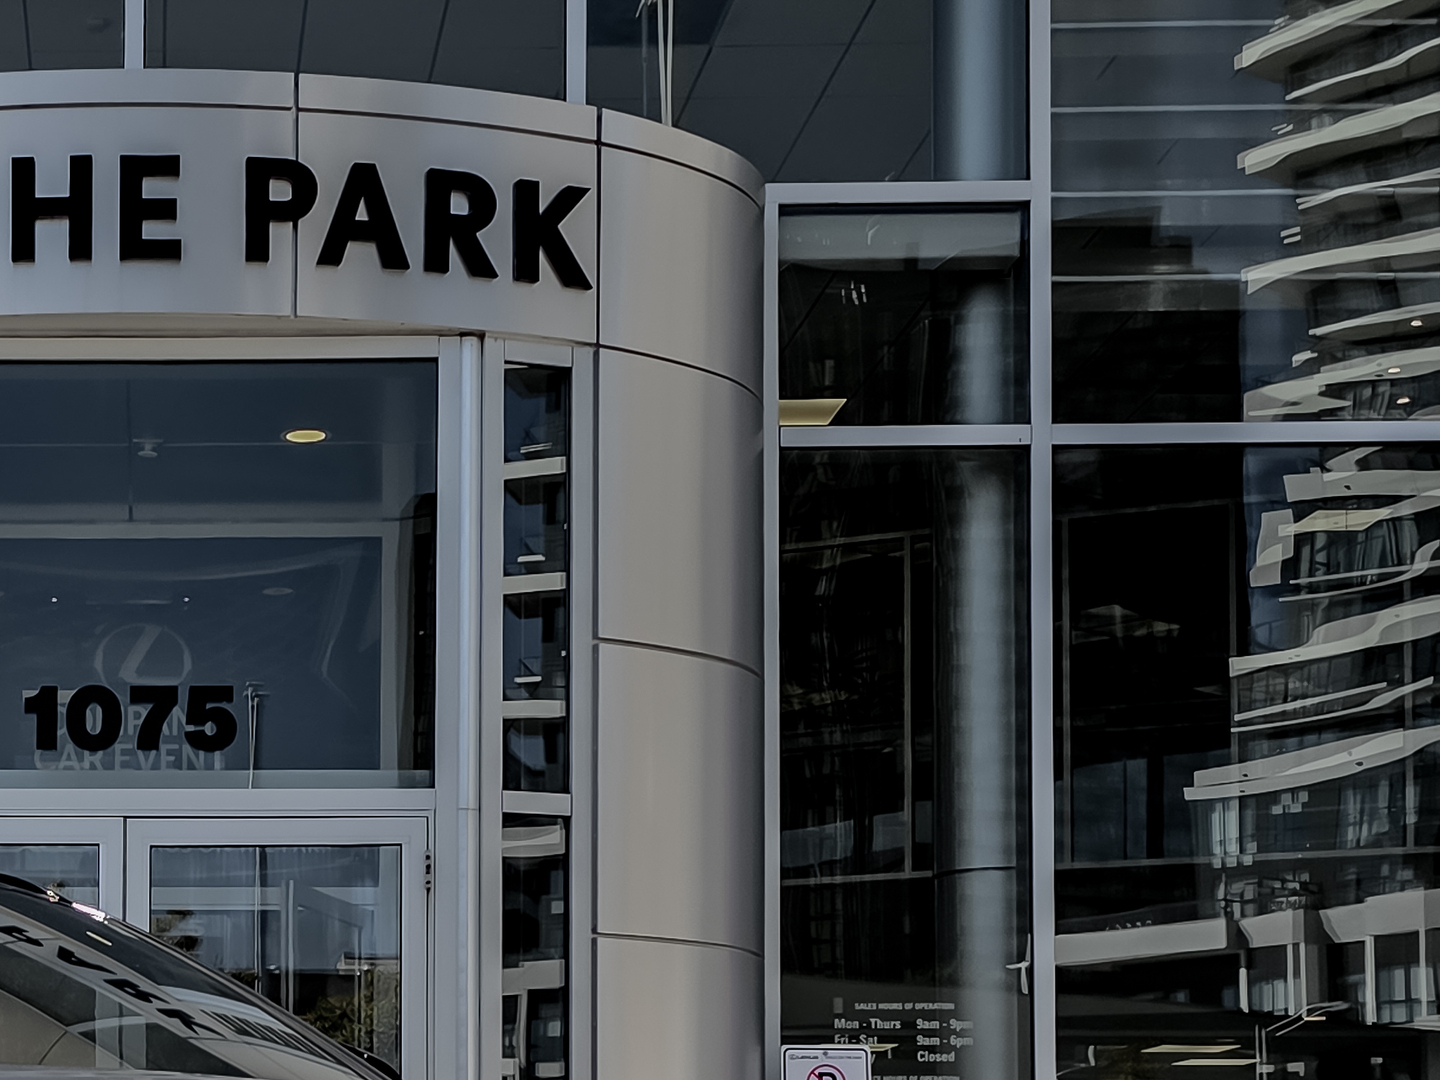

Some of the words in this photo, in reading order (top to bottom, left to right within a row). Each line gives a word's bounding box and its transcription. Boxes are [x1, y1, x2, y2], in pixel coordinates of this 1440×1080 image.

[245, 156, 594, 291] PARK
[24, 684, 237, 752] 1075
[834, 1018, 859, 1029] Mon
[869, 1018, 901, 1029] Thurs
[916, 1018, 939, 1029] 9am
[949, 1018, 973, 1032] 9pm
[834, 1035, 849, 1045] Fri
[859, 1035, 878, 1045] Sat
[916, 1035, 940, 1046] 9am
[950, 1035, 973, 1048] 6pm
[917, 1050, 955, 1062] Closed
